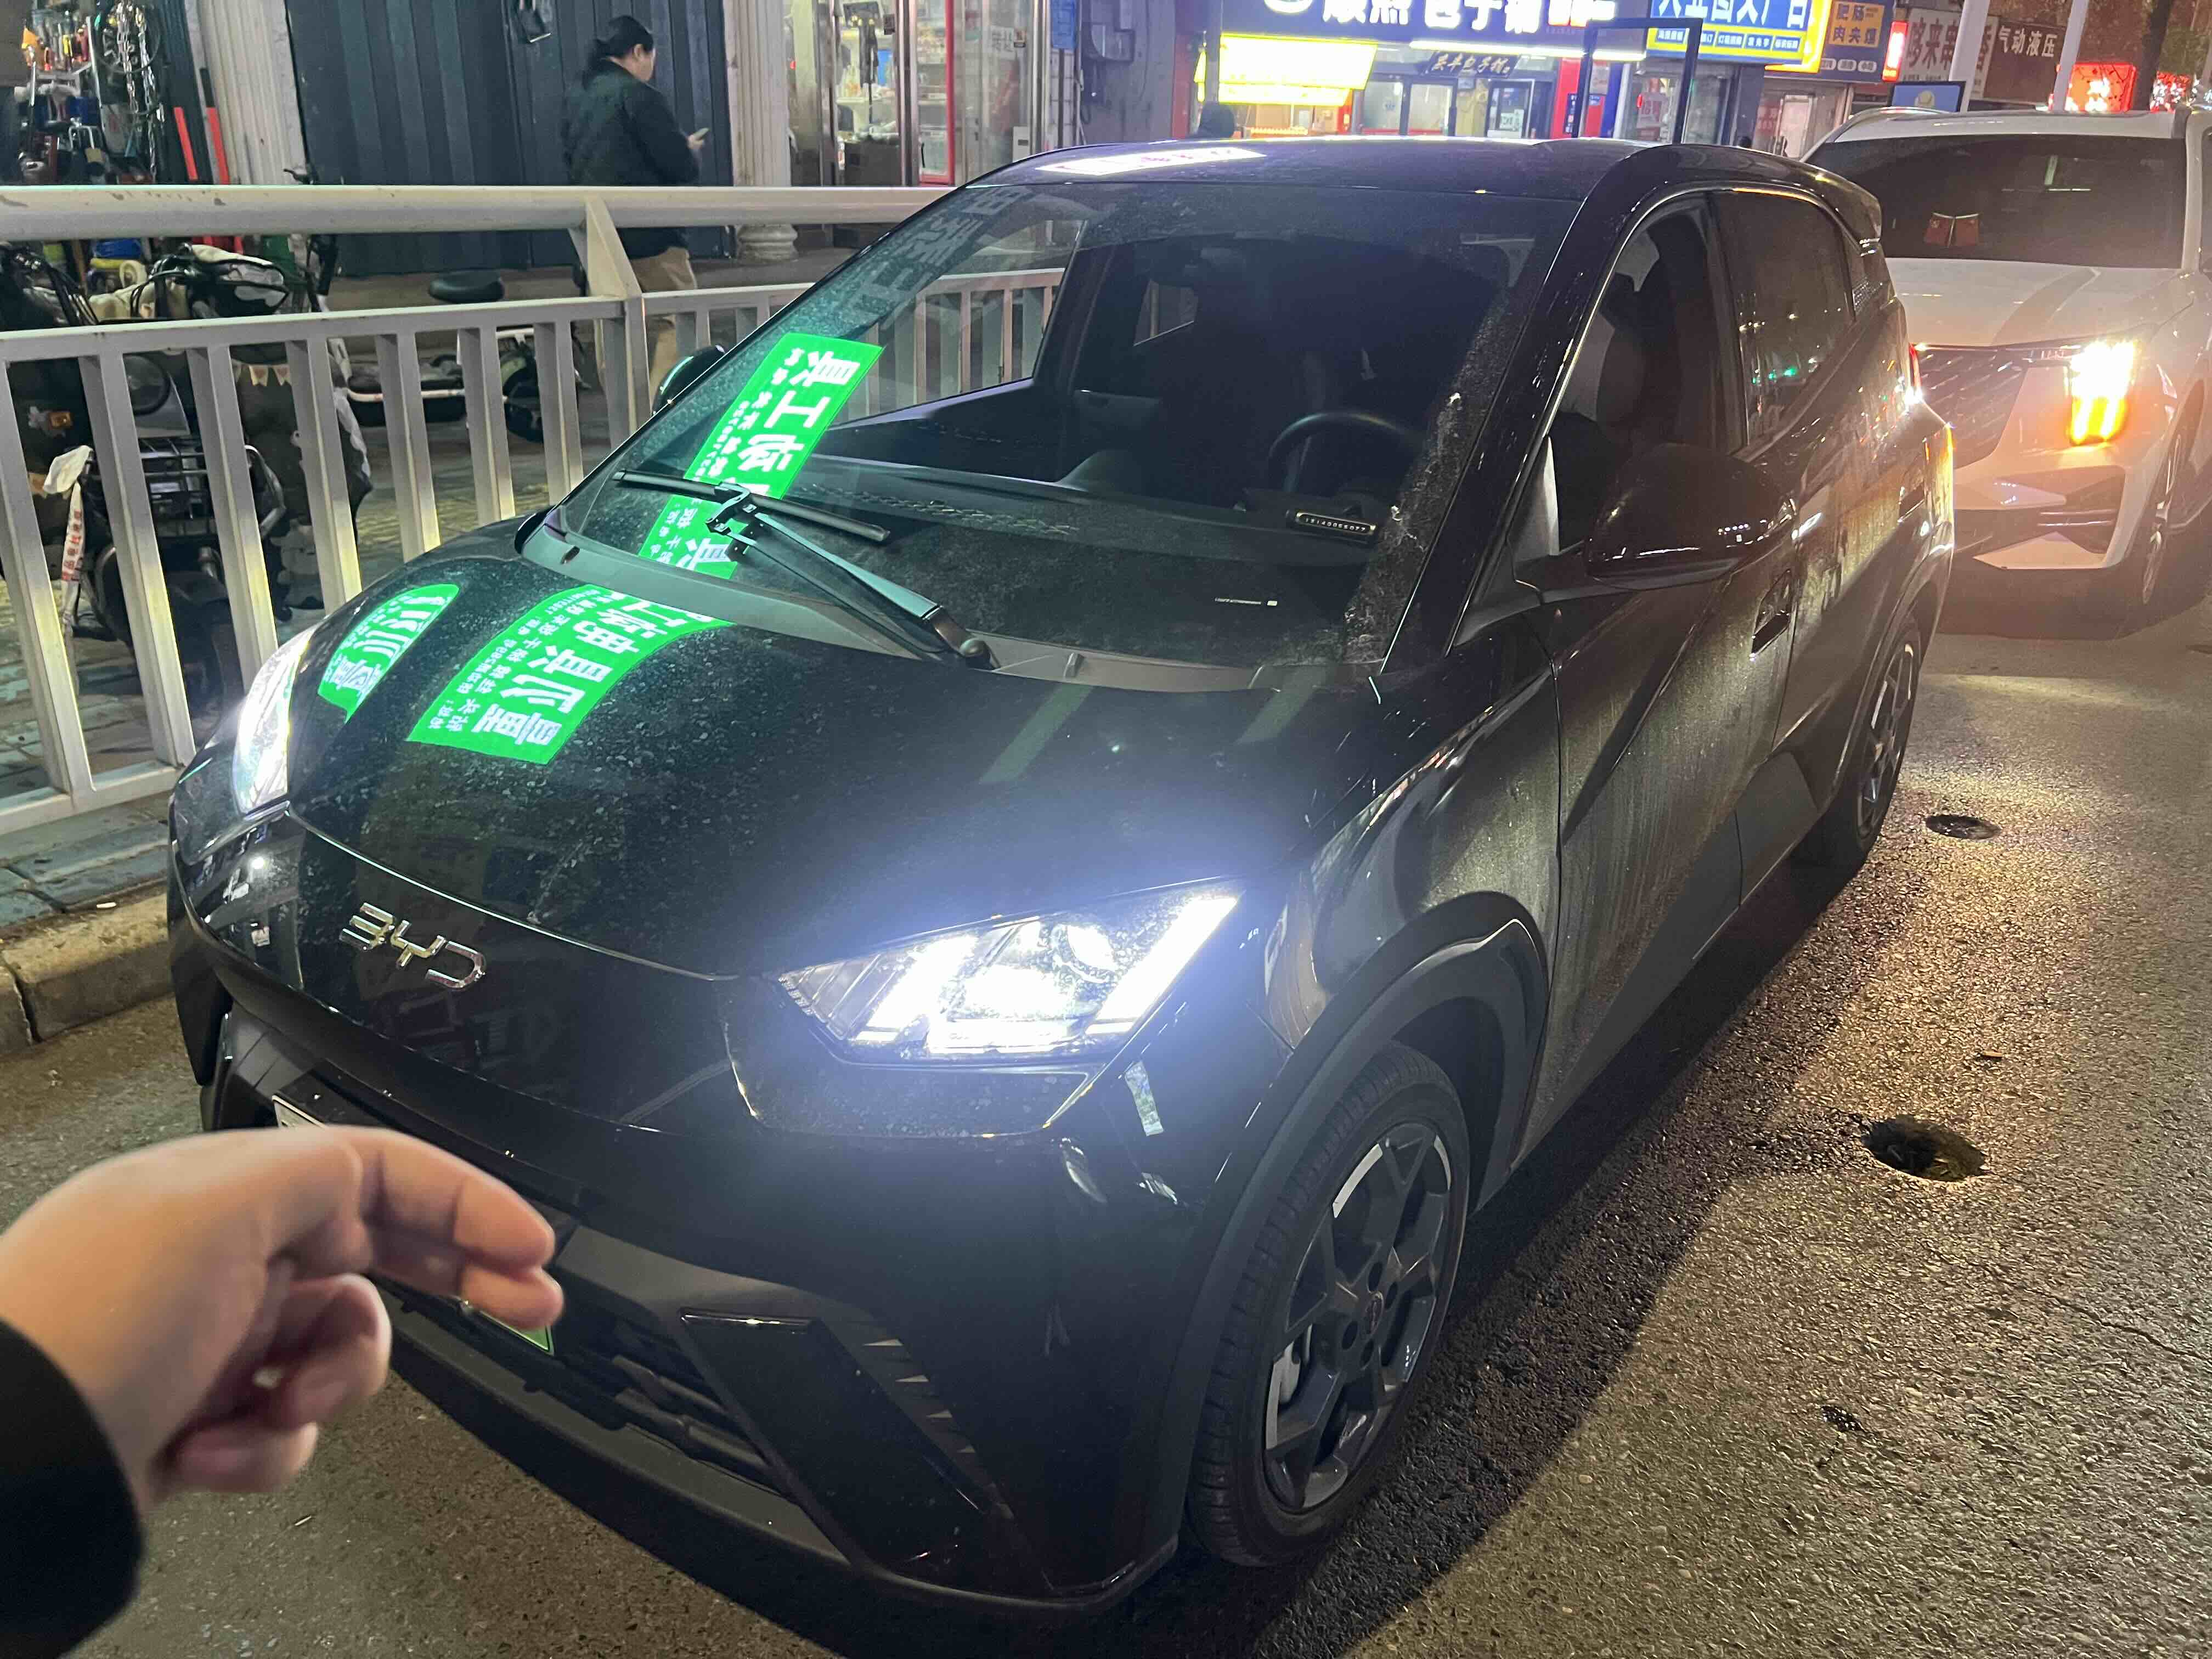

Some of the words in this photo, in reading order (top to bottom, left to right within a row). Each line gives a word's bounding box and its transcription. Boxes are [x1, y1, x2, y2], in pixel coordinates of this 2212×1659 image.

[1999, 25, 2057, 57] 气动液压
[338, 902, 487, 990] BYD
